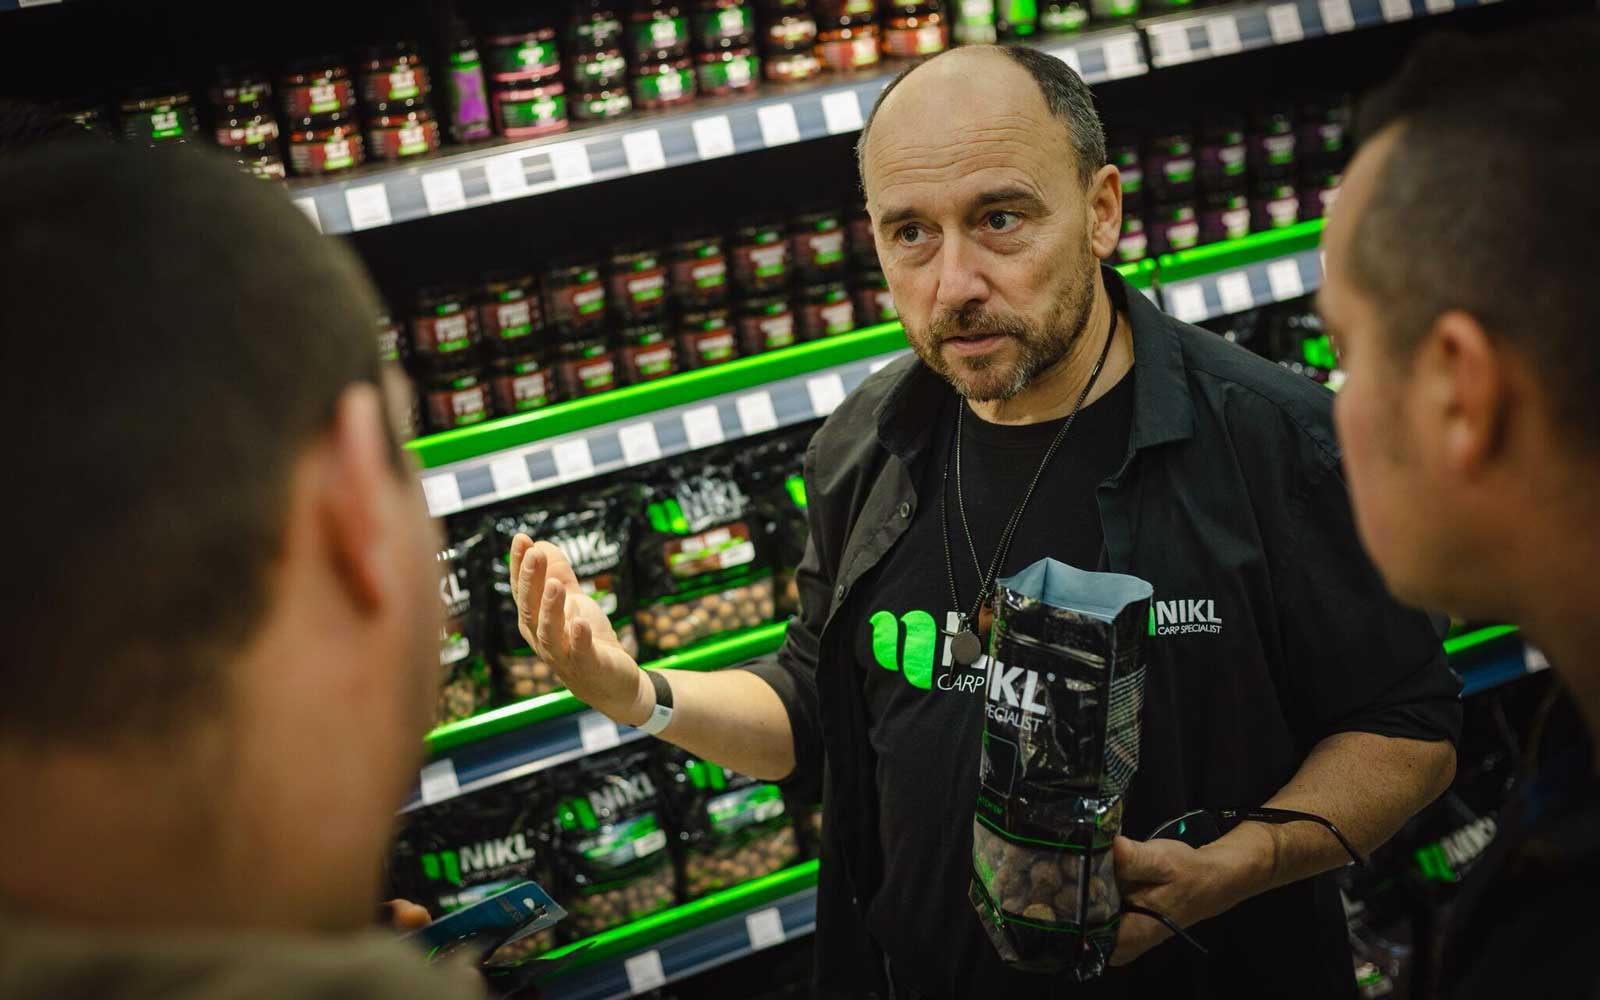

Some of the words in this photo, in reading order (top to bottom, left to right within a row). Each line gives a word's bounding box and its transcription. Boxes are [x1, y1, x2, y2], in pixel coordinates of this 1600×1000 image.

[1156, 599, 1223, 625] NIKL
[1158, 626, 1180, 635] CARP
[1180, 623, 1223, 634] SPECIALIST
[937, 673, 985, 694] CARP
[459, 833, 536, 873] NIKL
